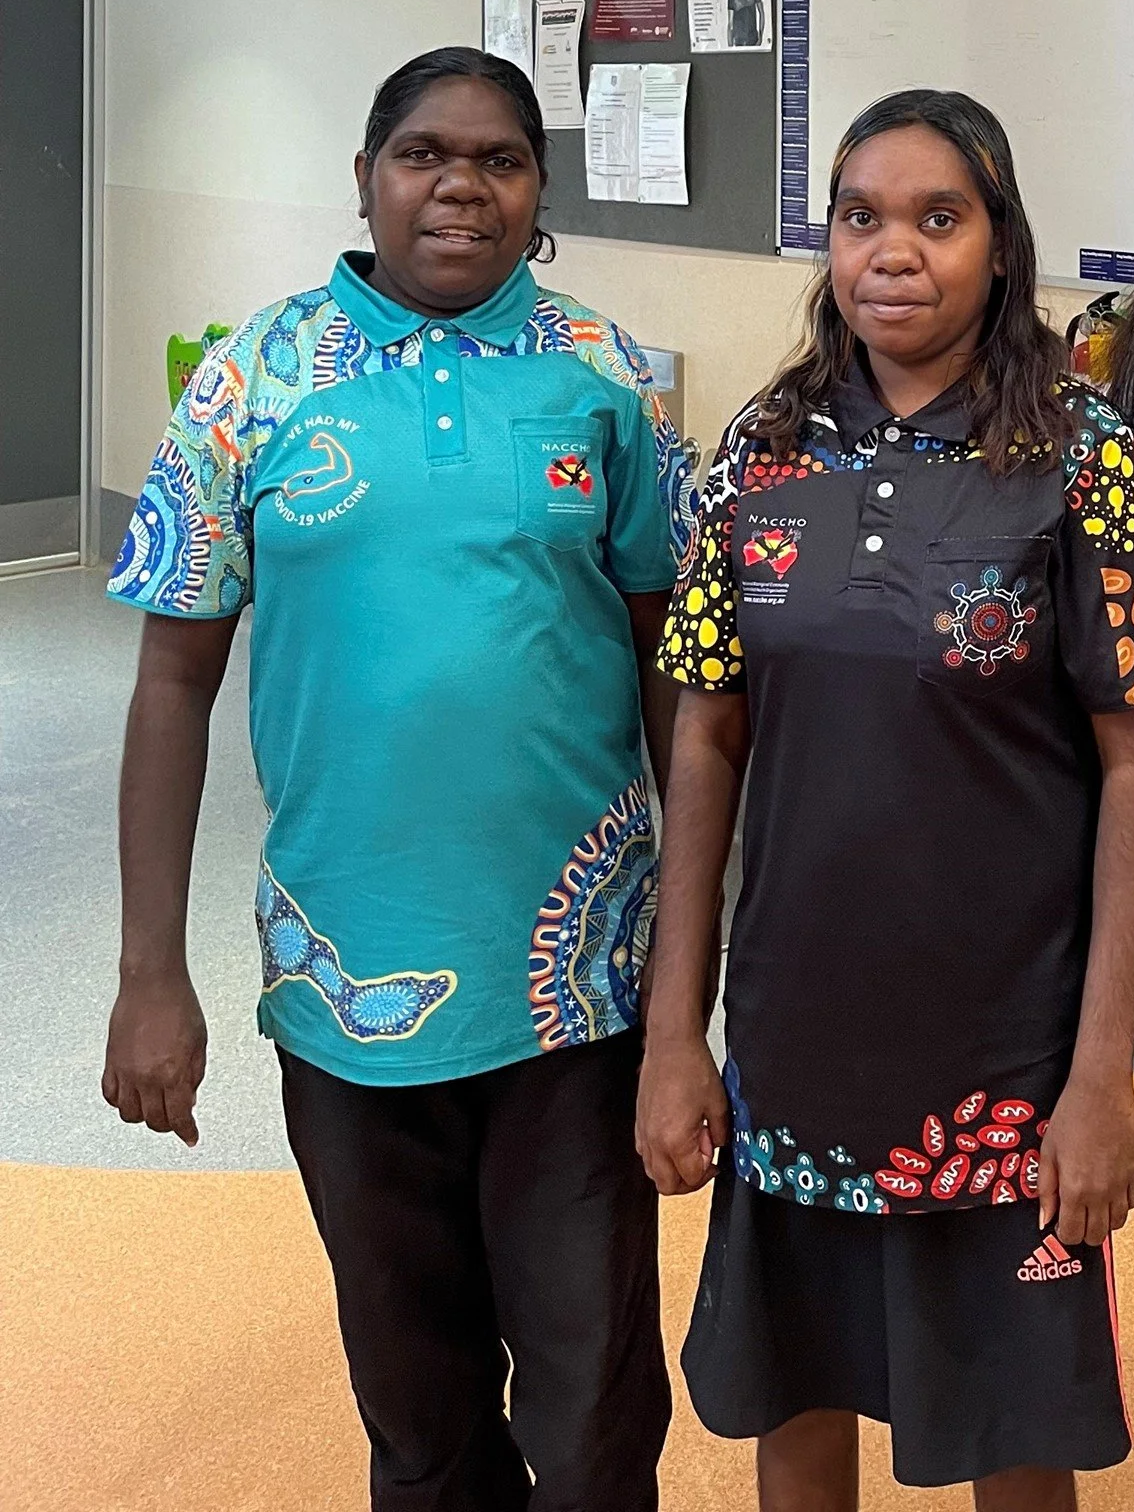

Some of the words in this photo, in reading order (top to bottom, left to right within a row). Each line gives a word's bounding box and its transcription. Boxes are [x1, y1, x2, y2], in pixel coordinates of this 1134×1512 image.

[304, 415, 335, 430] HAD
[336, 418, 360, 433] MY
[274, 490, 315, 526] COVID-19
[316, 479, 371, 524] VACCINE
[748, 514, 807, 527] NACCHO
[1016, 1259, 1083, 1281] adidas
